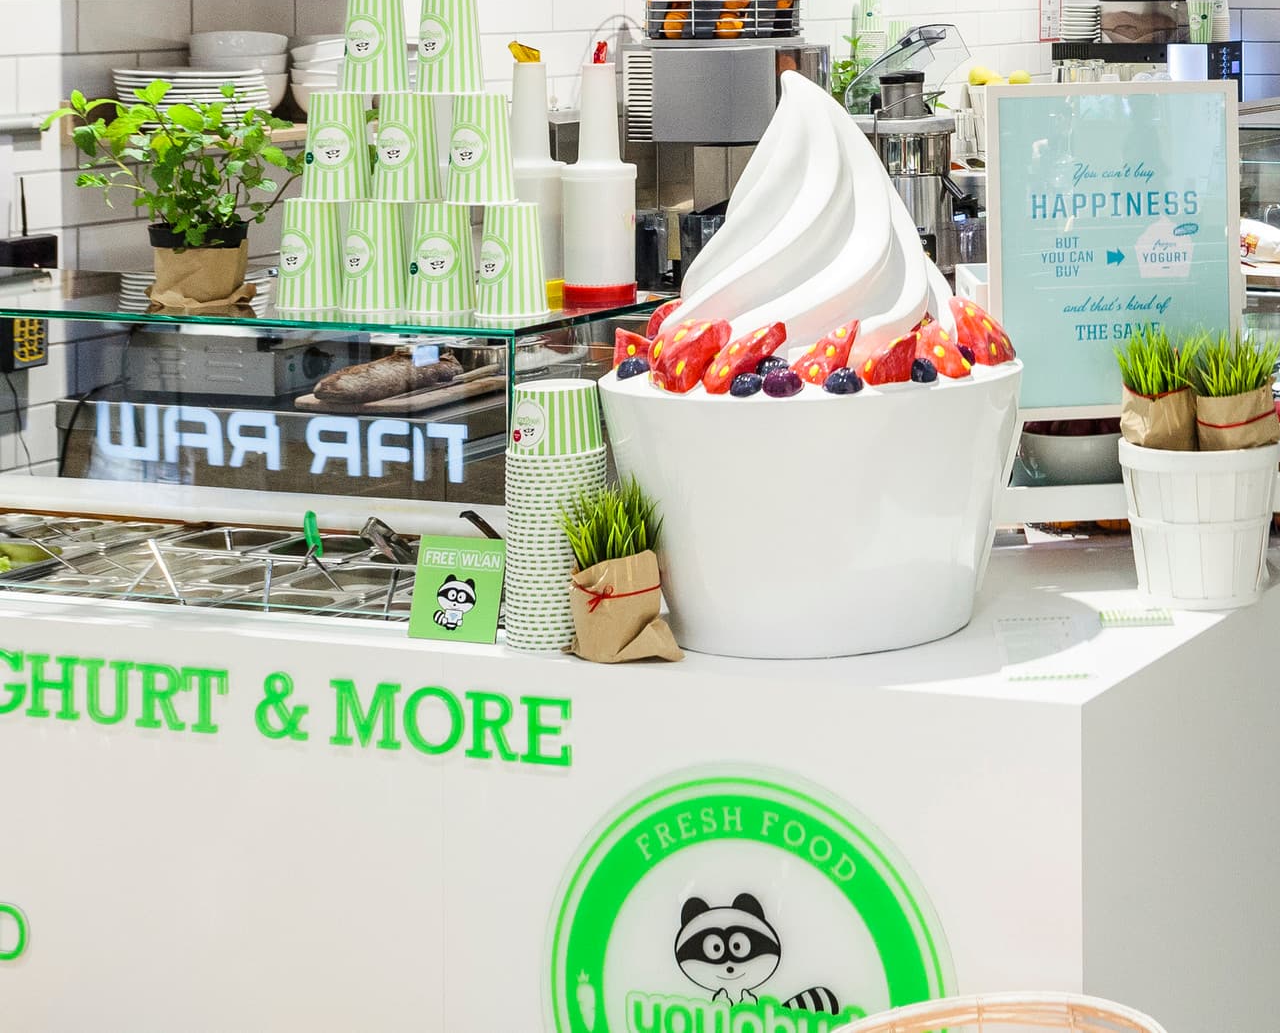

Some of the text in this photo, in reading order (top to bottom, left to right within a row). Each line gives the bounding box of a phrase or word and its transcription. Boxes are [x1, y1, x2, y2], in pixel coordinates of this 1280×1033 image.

[1072, 163, 1155, 187] You can't buy
[1031, 190, 1200, 219] HAPPINESS
[1055, 236, 1080, 250] BUT
[1041, 250, 1094, 264] YOU CAN
[1142, 251, 1188, 264] YOGURT
[1055, 266, 1080, 279] BUY
[1063, 295, 1172, 314] and that's kind of
[1075, 323, 1108, 341] THE
[424, 549, 501, 569] FREE WLAN
[0, 648, 573, 767] GHURT & MORE
[634, 805, 857, 883] FRESH FOOD
